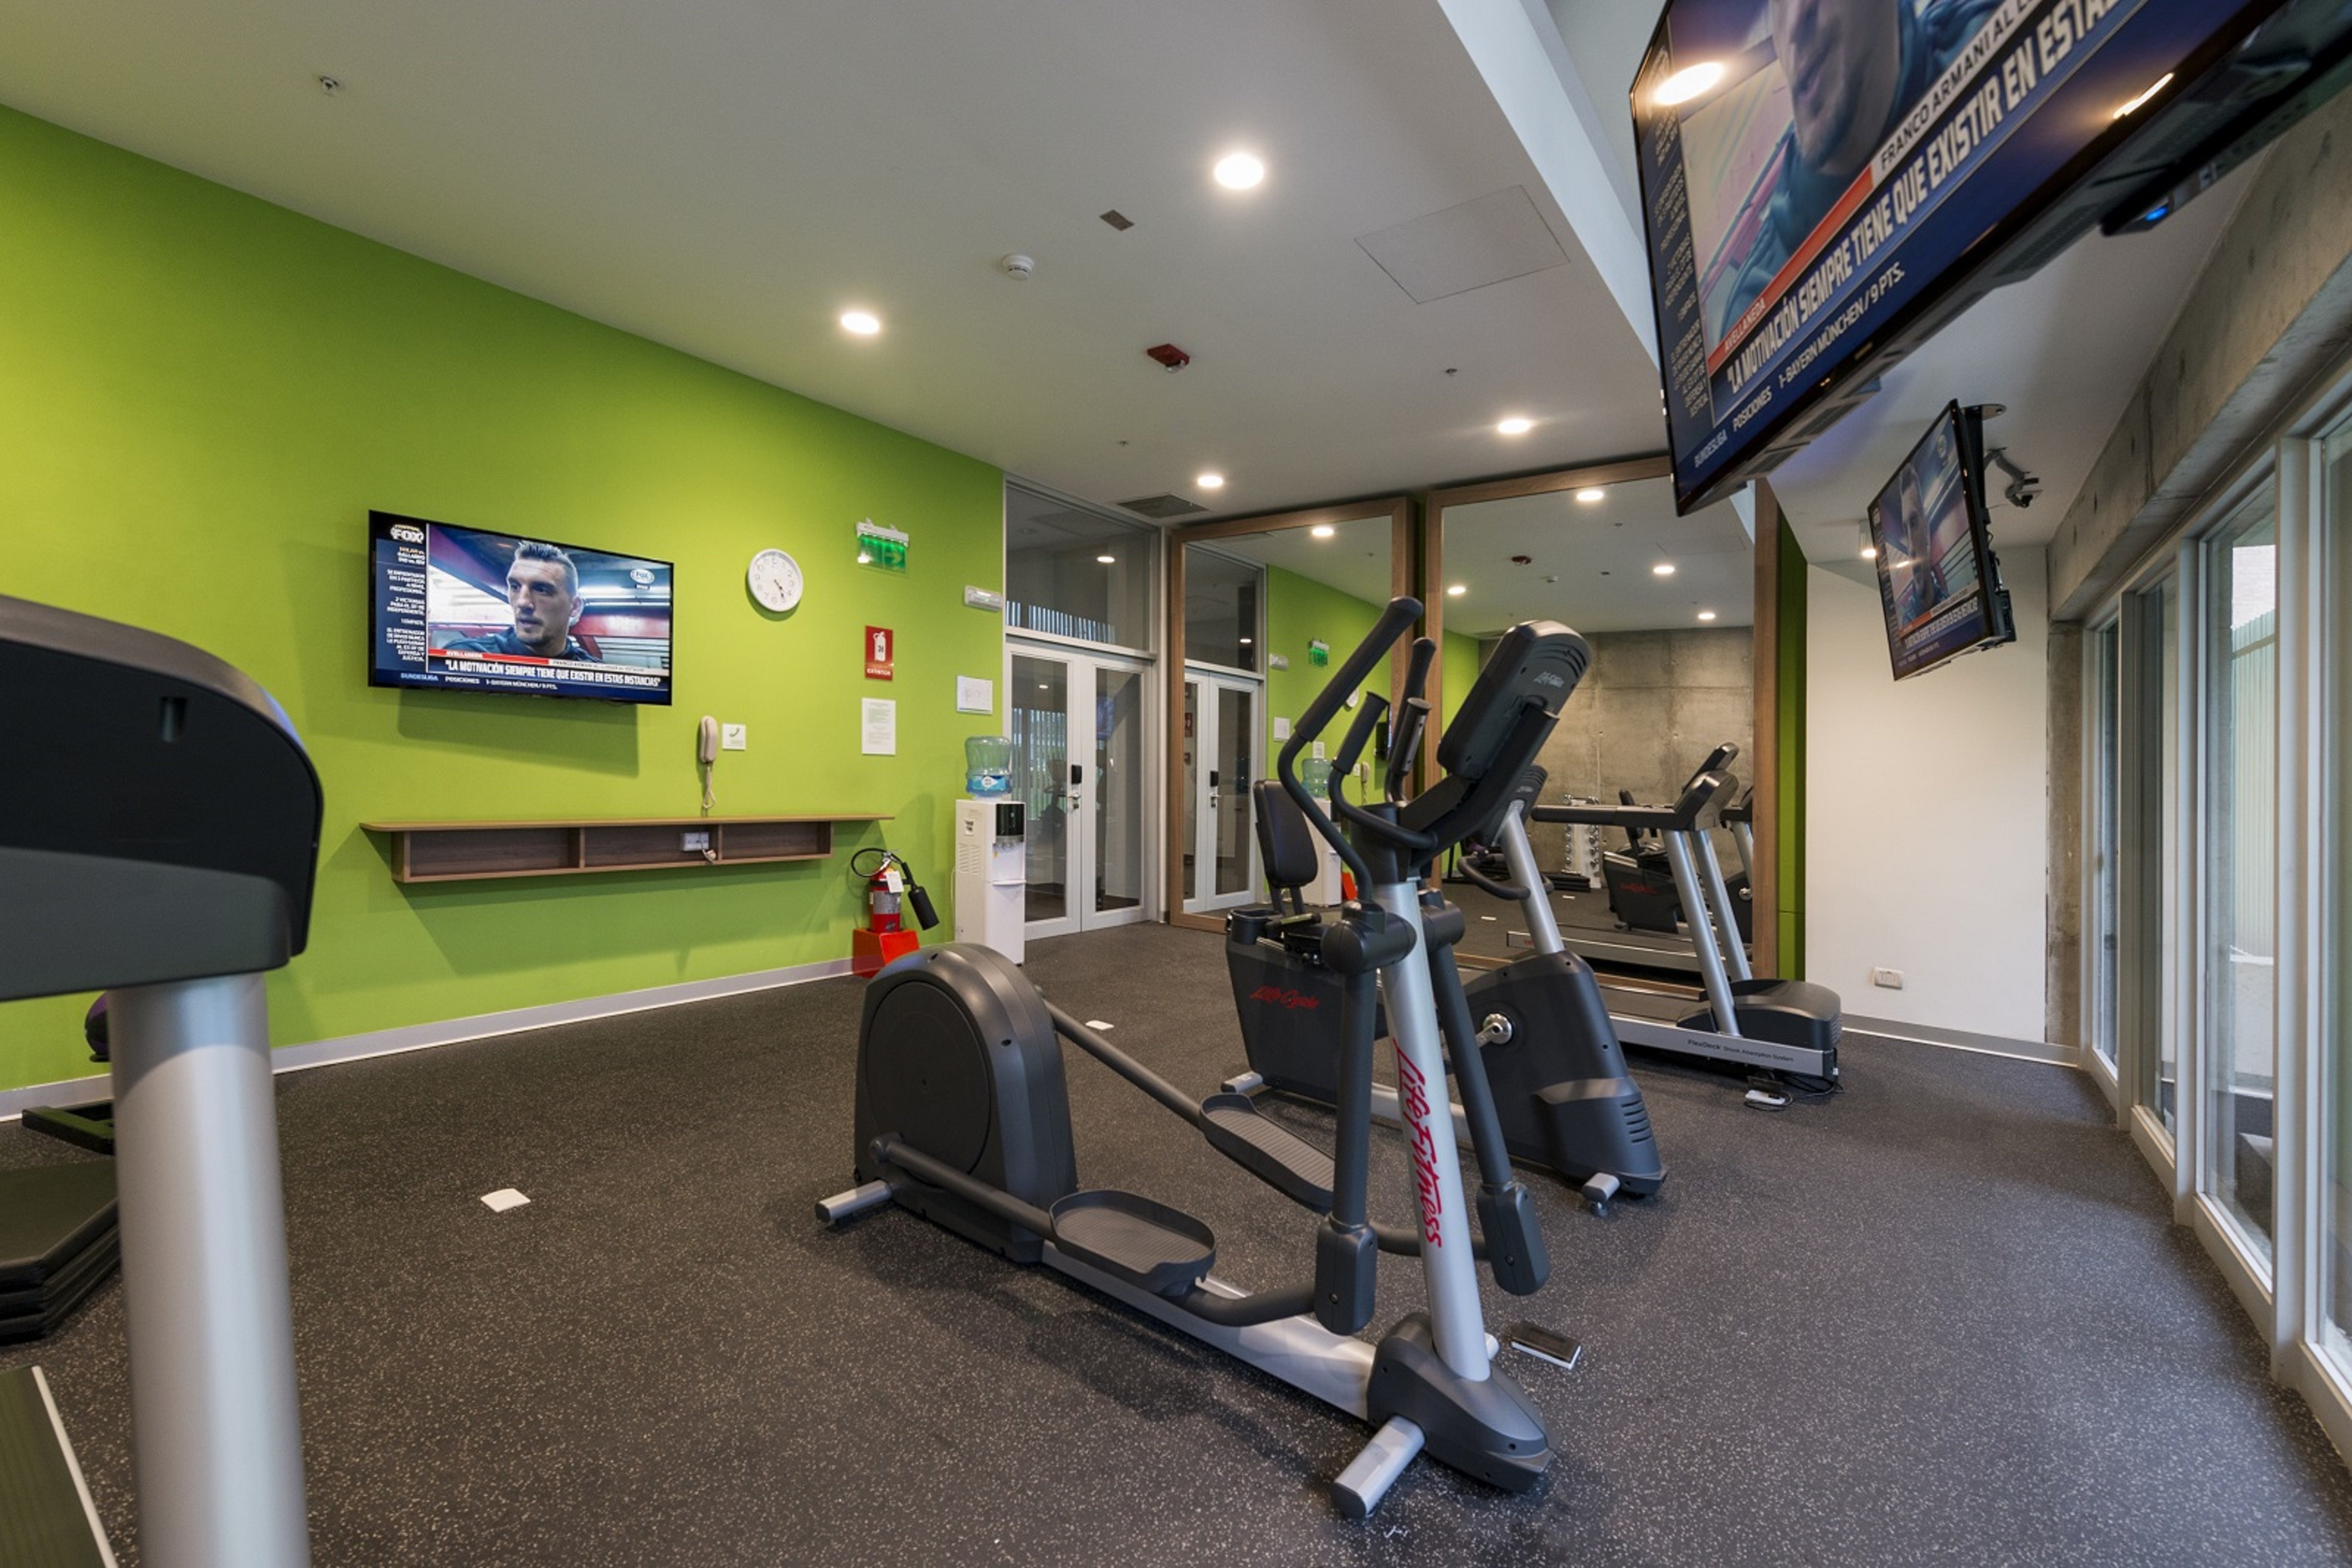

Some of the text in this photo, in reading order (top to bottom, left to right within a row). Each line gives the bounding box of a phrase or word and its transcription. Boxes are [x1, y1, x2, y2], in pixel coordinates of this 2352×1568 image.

[1881, 9, 2014, 170] FRANCO ARMANI AL
[1741, 297, 1798, 382] MOTIVACIÓN
[1798, 237, 1853, 324] SIEMPRE
[1851, 193, 1893, 266] TIENE
[1892, 156, 1927, 224] QUE
[1926, 75, 2003, 189] EXISTIR
[2002, 37, 2037, 112] EN
[2036, 0, 2118, 76] ESTA
[1694, 429, 1727, 468] BUNDESLIGA
[1733, 386, 1772, 432] POSICIONES
[1816, 302, 1863, 349] MÜNCHEN
[1871, 288, 1878, 303] 9
[1879, 261, 1906, 296] PTS.
[1724, 299, 1766, 352] AVELLANEDA
[393, 529, 422, 544] FOX
[460, 660, 504, 674] MOTIVACIÓN
[506, 664, 536, 676] SIEMPRE
[537, 667, 555, 678] TIENE
[556, 669, 569, 680] QUE
[570, 670, 594, 682] EXISTIR
[595, 673, 603, 683] EN
[604, 673, 624, 684] ESTAS
[1688, 1039, 1720, 1050] FlexDeck
[1393, 1037, 1442, 1248] Life Fitness
